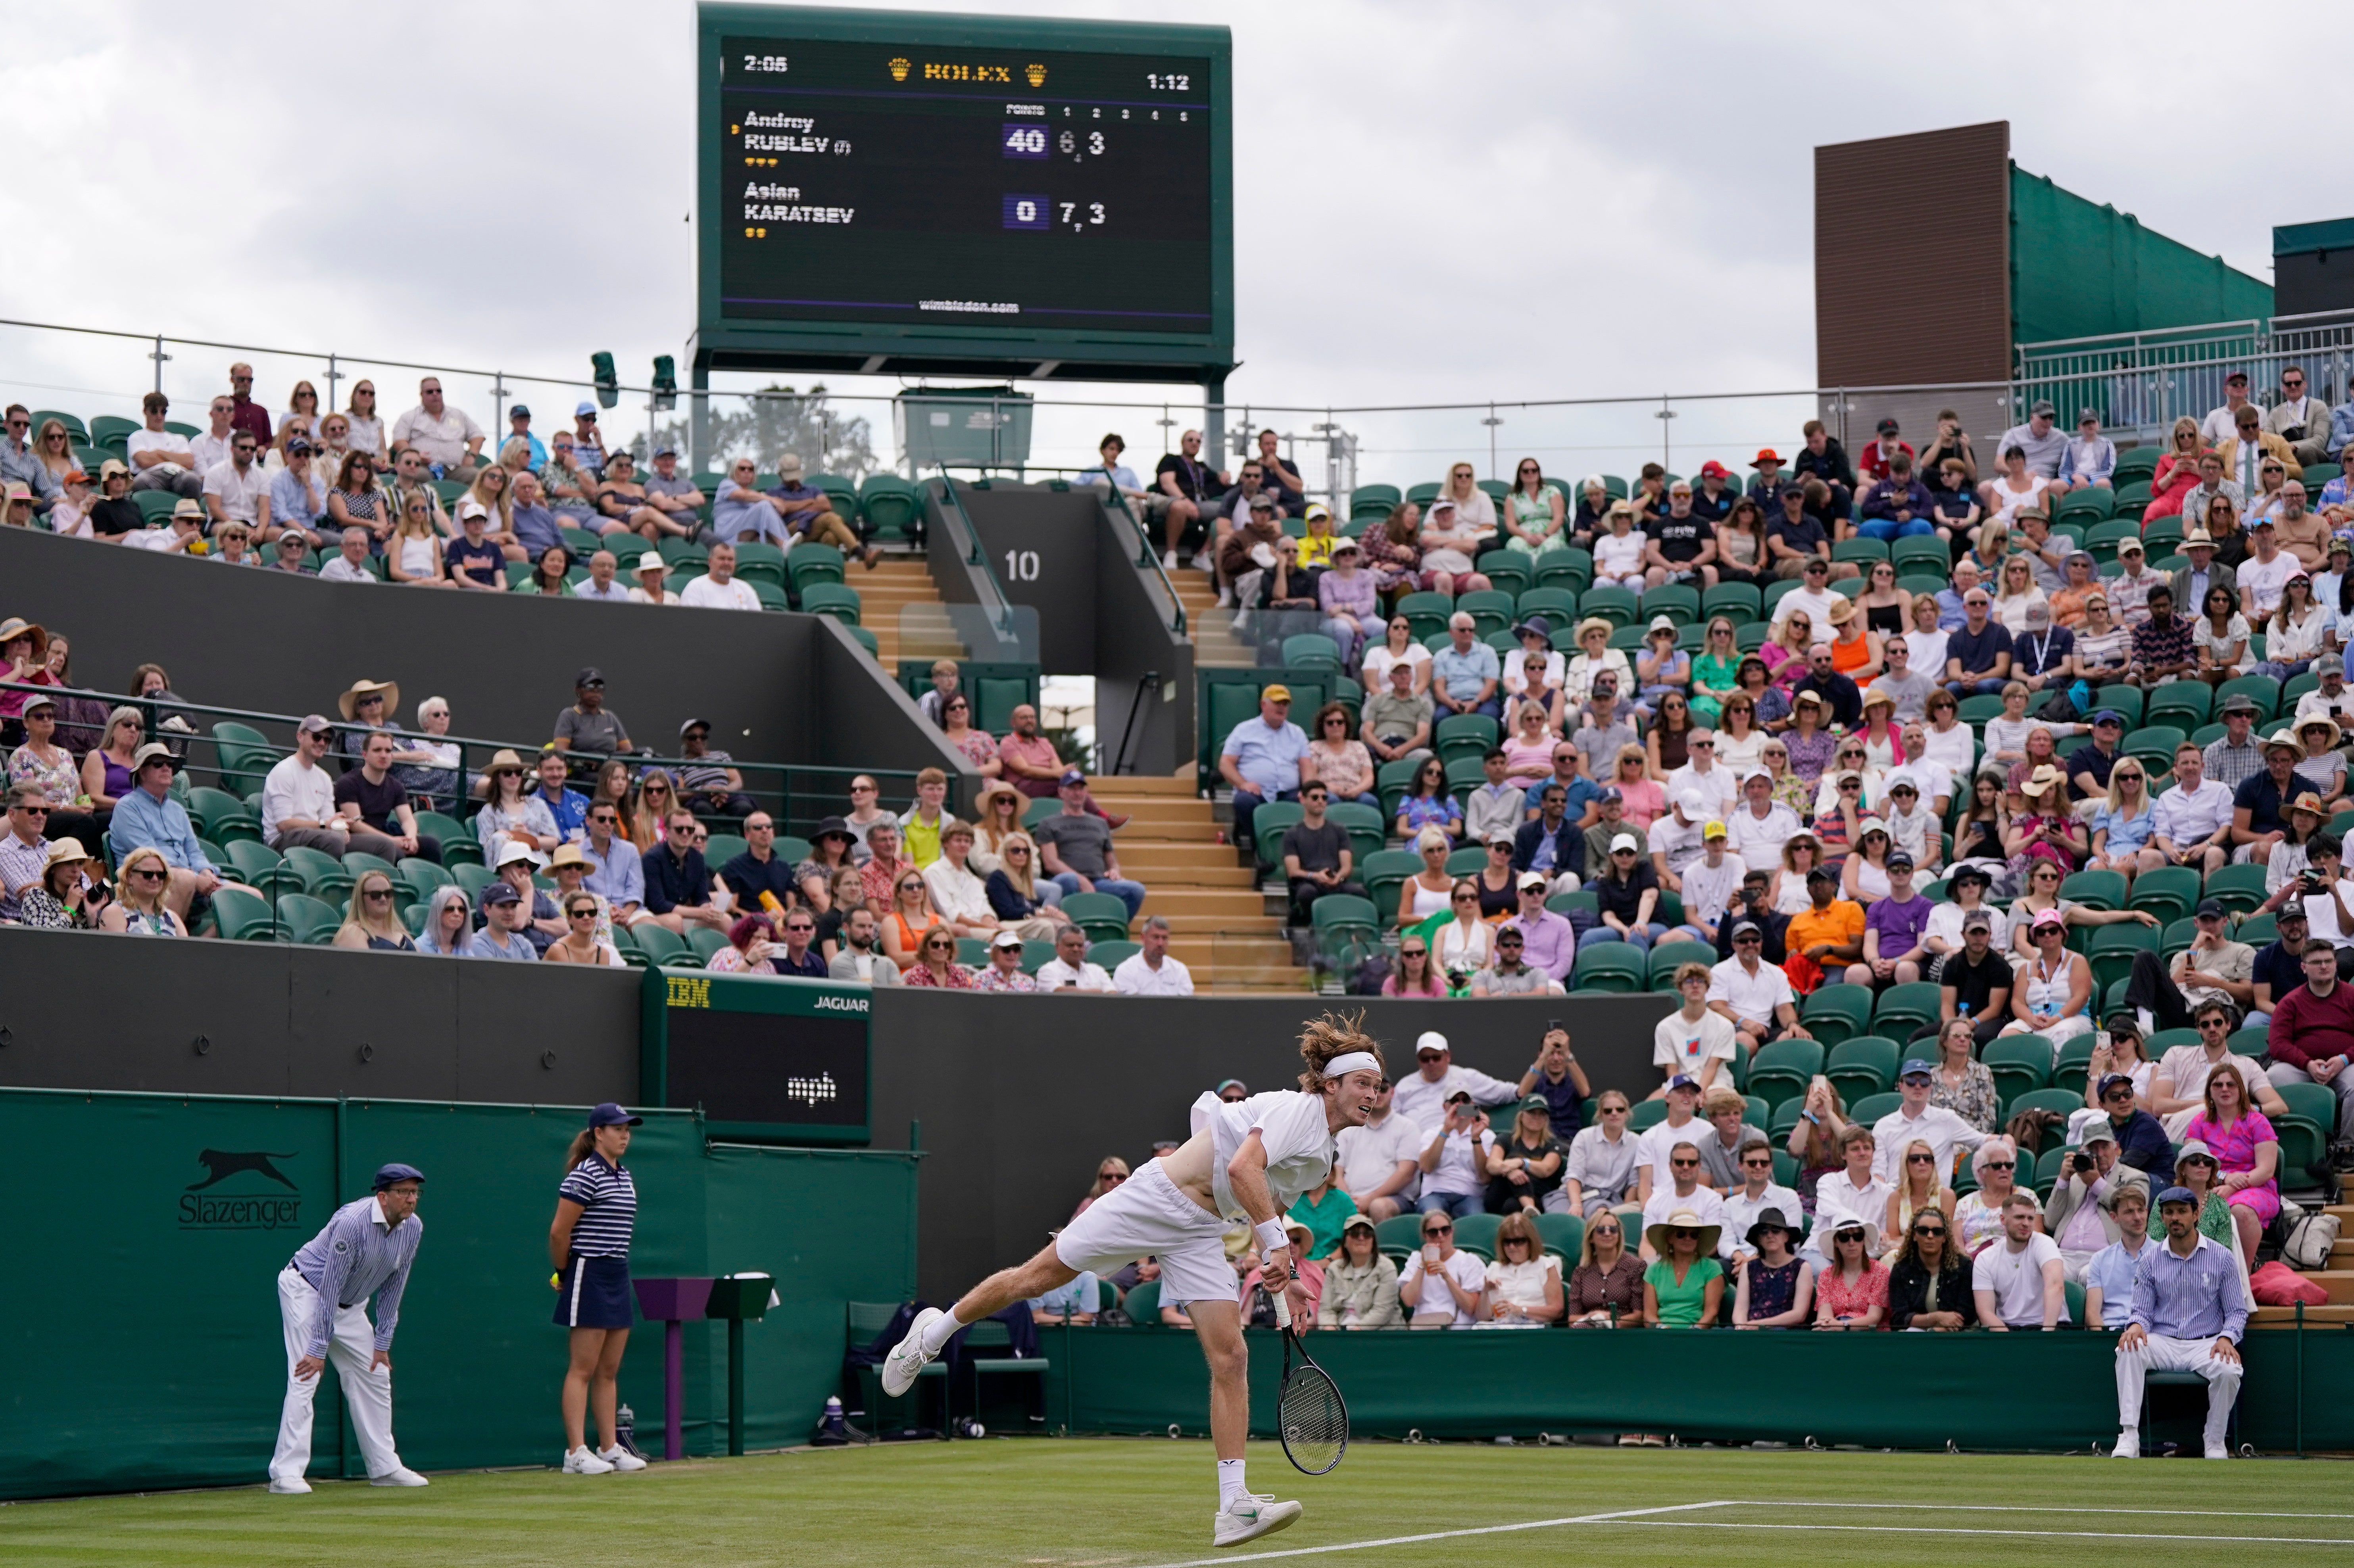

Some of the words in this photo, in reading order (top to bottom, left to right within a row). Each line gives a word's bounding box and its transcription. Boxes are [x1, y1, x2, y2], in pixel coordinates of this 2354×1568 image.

[925, 63, 1011, 82] ROLEX
[1147, 74, 1189, 90] 1:12
[744, 111, 814, 133] Andrey
[745, 134, 829, 152] RUBLEV
[1006, 129, 1045, 153] 40
[1059, 131, 1075, 153] 6
[1089, 132, 1105, 155] 3
[745, 204, 855, 223] KARATSEV
[1017, 201, 1036, 221] 0
[1059, 202, 1076, 223] 7
[1090, 202, 1105, 224] 3
[1005, 550, 1040, 581] 10
[667, 977, 710, 1008] IBM
[814, 996, 869, 1012] JAGUAR
[788, 1072, 836, 1107] mph
[178, 1194, 301, 1230] Slazenger
